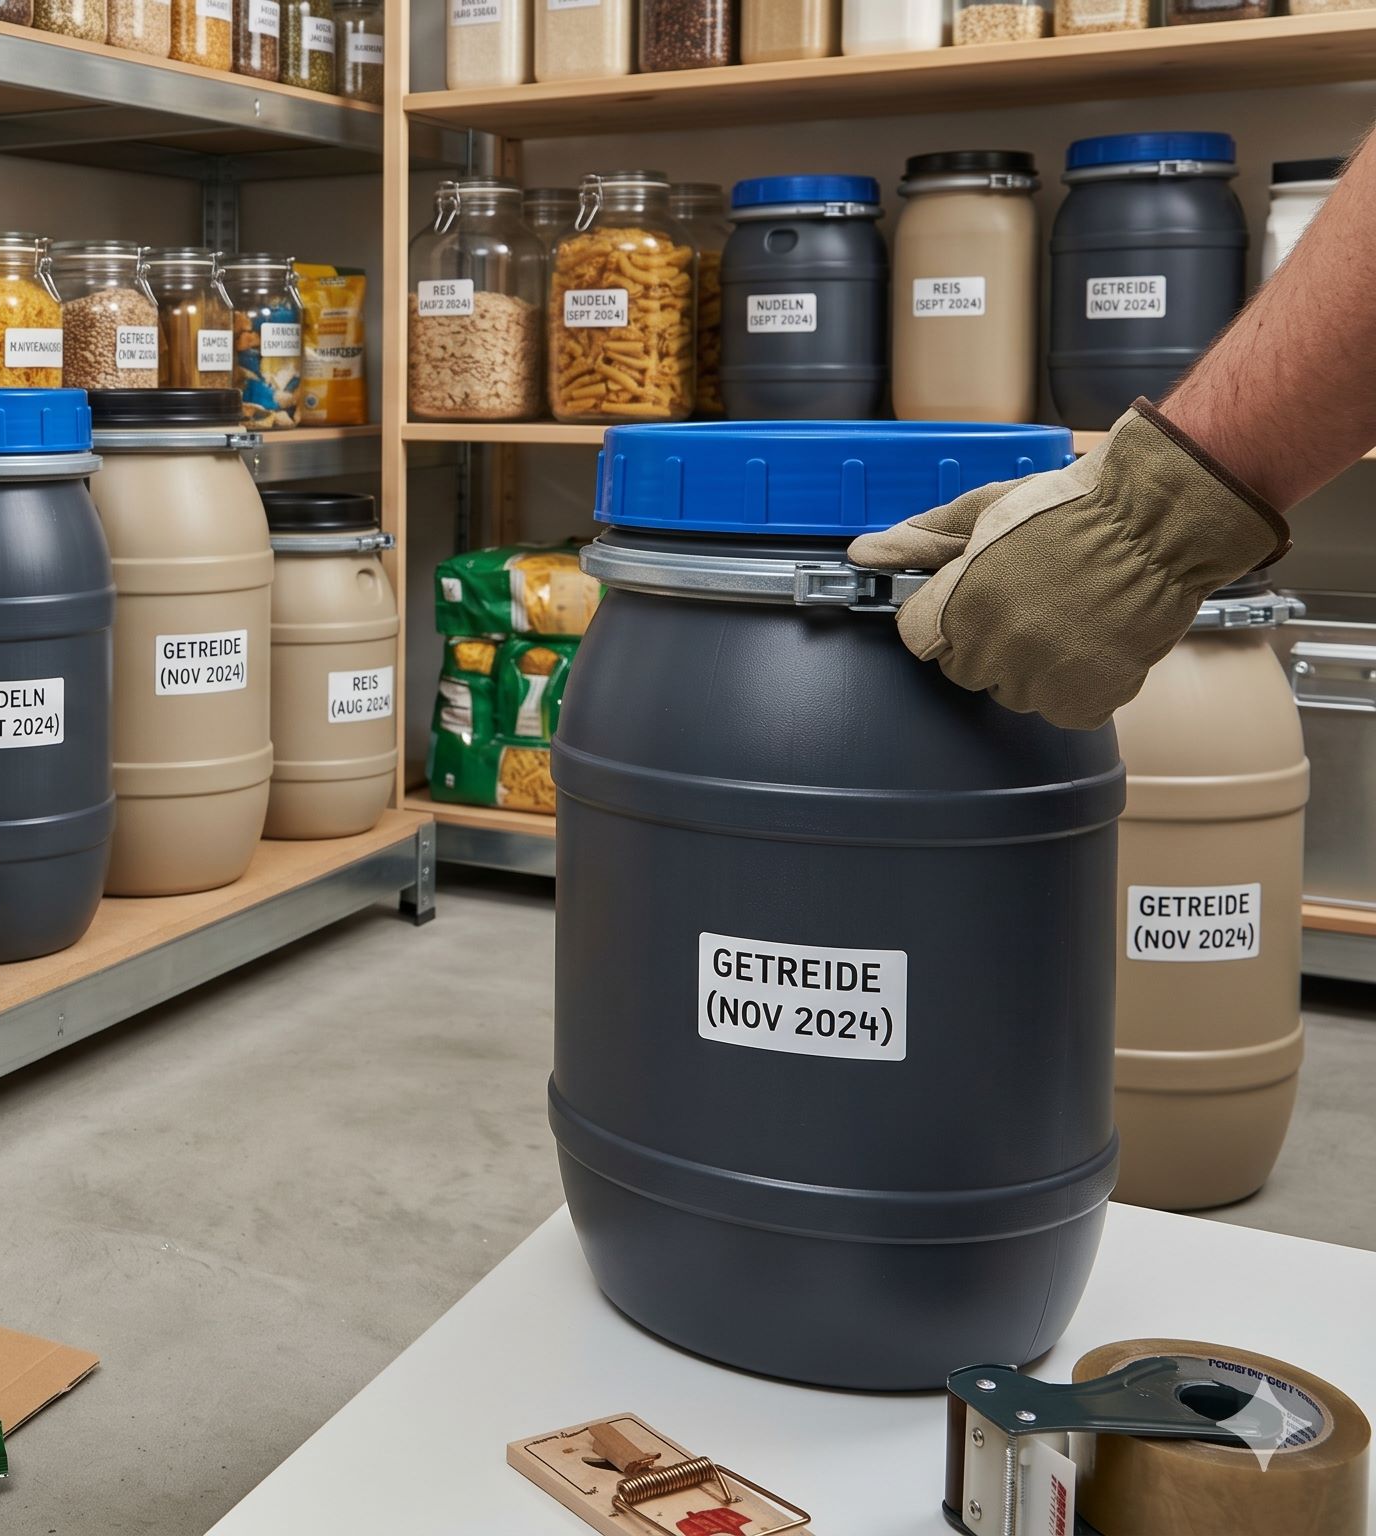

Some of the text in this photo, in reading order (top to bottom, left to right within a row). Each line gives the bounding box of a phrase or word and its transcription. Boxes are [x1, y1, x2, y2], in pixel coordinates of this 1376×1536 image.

[433, 284, 456, 296] REIS
[933, 282, 961, 294] REIS
[1092, 281, 1156, 295] GETREIDE
[571, 295, 616, 306] NUDELN
[757, 299, 804, 311] NUDELN
[916, 297, 982, 312] (SEPT 2024)
[1090, 298, 1161, 313] (NOV 2024)
[750, 314, 813, 326] (SEPT 2024)
[163, 637, 241, 659] GETREIDE
[160, 661, 244, 689] (NOV 2024)
[352, 674, 379, 691] REIS
[331, 698, 363, 718] (AUG
[12, 713, 60, 737] 2024)
[1139, 893, 1250, 917] GETREIDE
[1134, 922, 1254, 952] (NOV 2024)
[713, 948, 881, 993] GETREIDE
[706, 989, 893, 1047] (NOV 2024)
